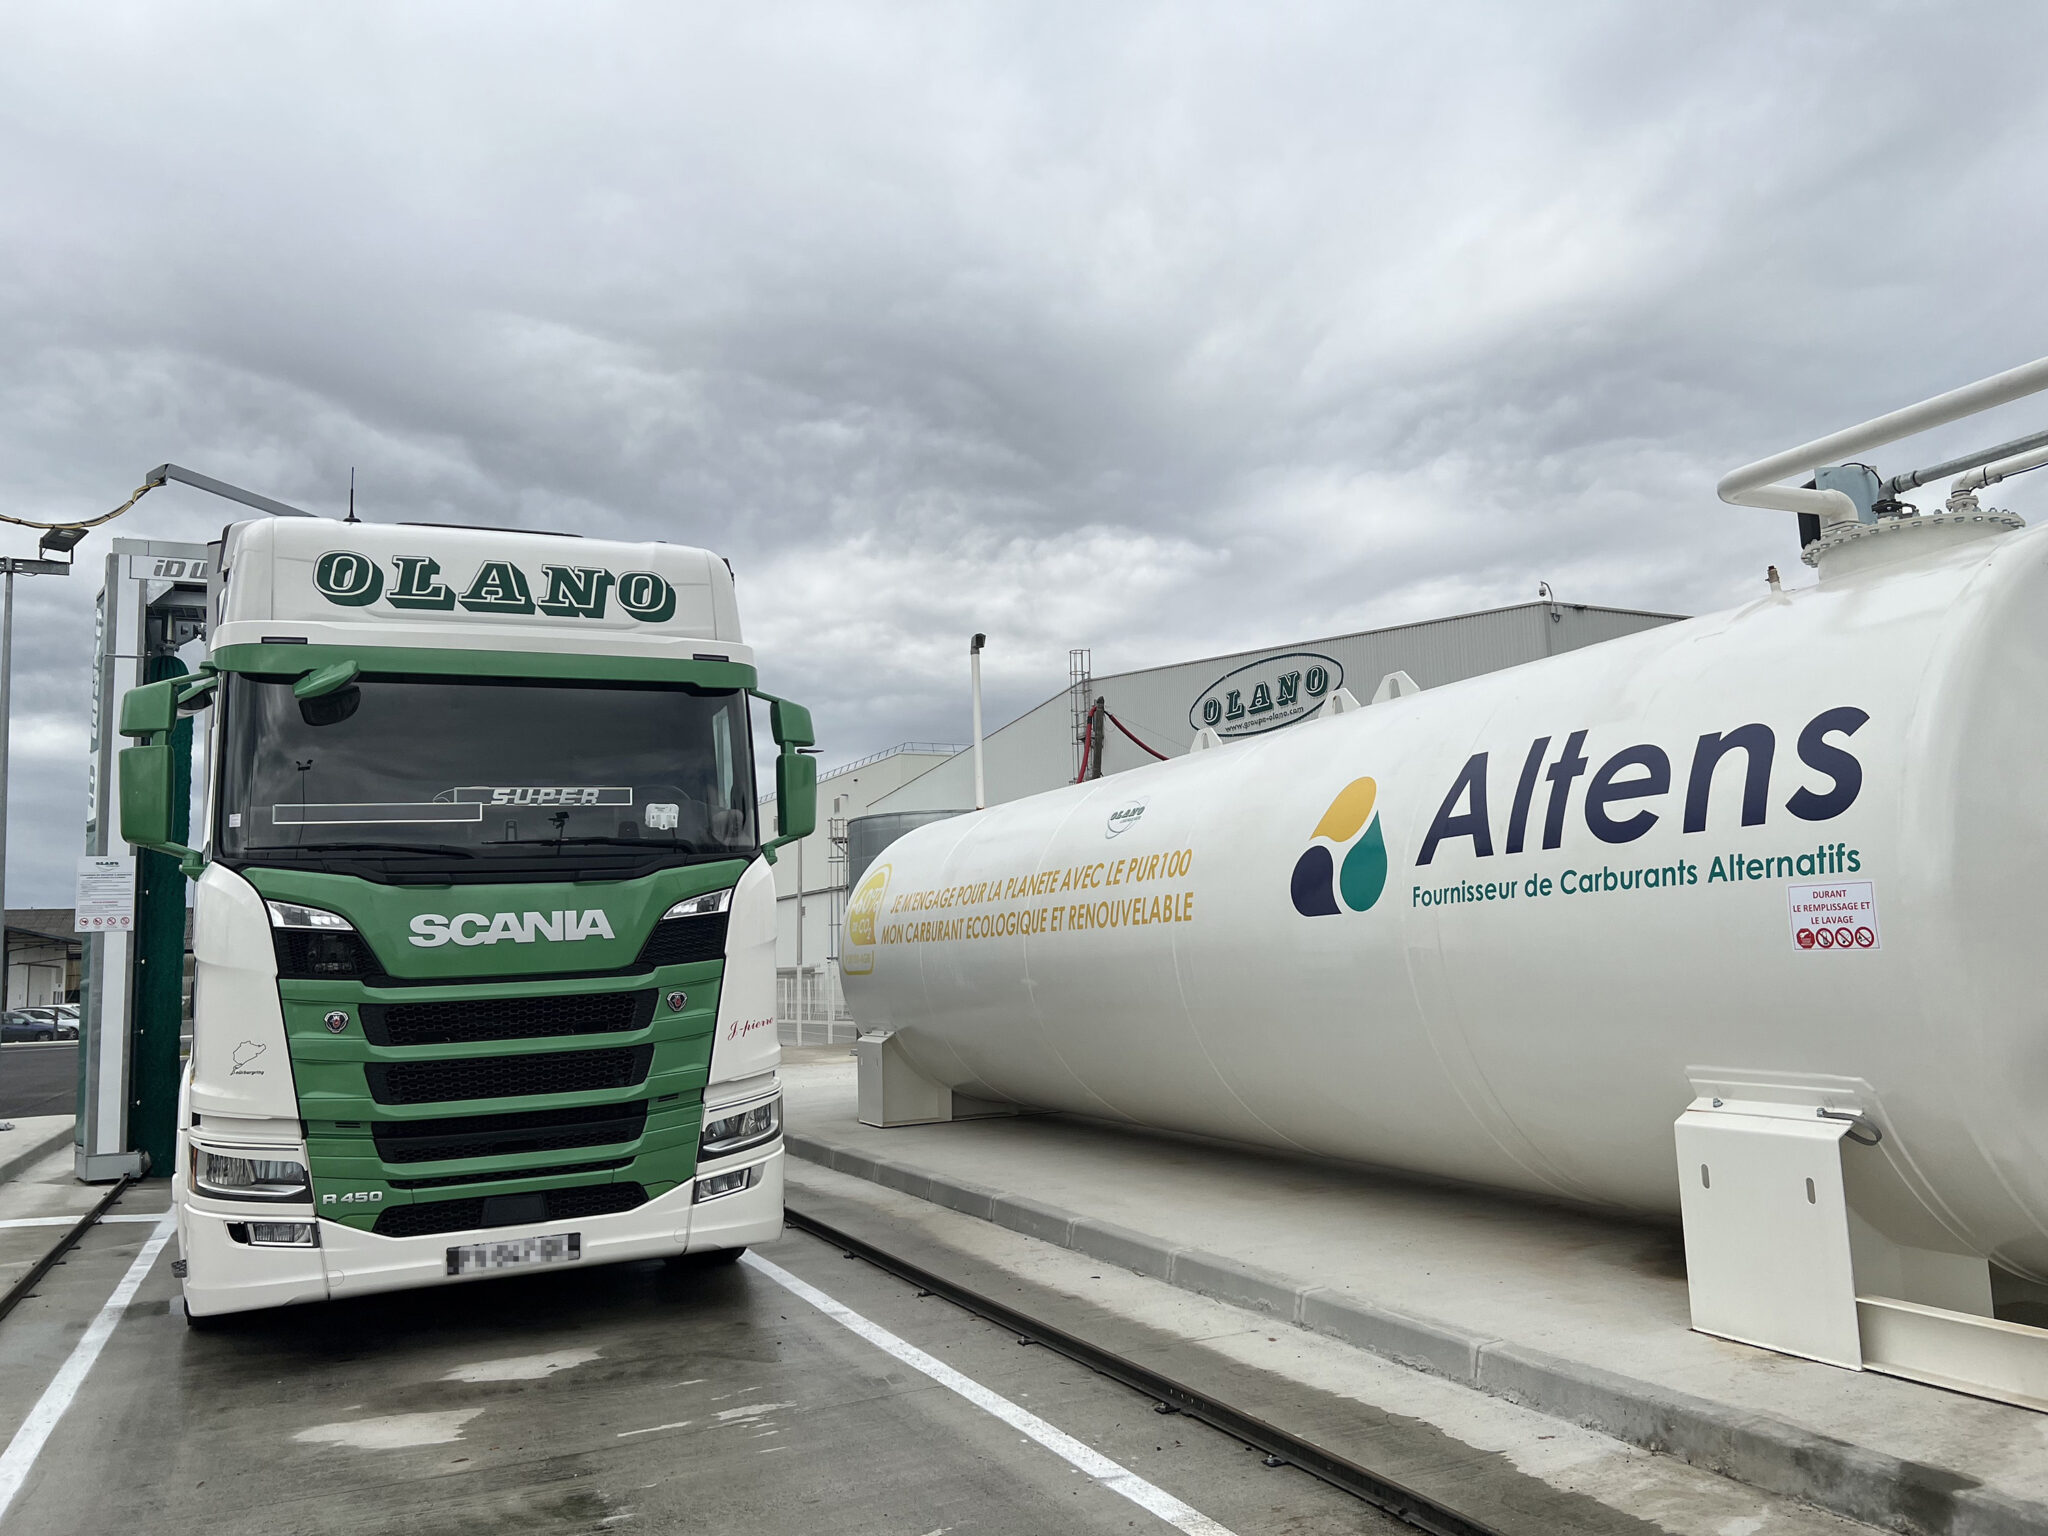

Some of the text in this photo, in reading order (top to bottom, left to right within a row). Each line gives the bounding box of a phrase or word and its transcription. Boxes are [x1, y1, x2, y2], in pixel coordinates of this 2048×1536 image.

[312, 550, 677, 624] OLANO
[1203, 664, 1329, 726] OLANO
[1224, 706, 1305, 733] www.groupe-olano.com
[490, 788, 600, 806] SUPER
[1415, 706, 1871, 867] Altens
[1110, 805, 1146, 821] OLANO
[889, 894, 903, 914] JE
[902, 886, 957, 913] M'ENGAGE
[955, 881, 988, 906] POUR
[987, 879, 1003, 902] LA
[1004, 869, 1061, 900] PLANETE
[1059, 862, 1105, 893] AVEC
[1105, 859, 1126, 886] LE
[1412, 842, 1862, 908] Fournisseur de Carburants Alternatifs
[1792, 901, 1871, 913] LE REMPLISSAGE ET
[1812, 889, 1847, 899] DURANT
[408, 908, 616, 948] SCANIA
[880, 923, 903, 945] MON
[905, 917, 965, 944] CARBURANT
[966, 907, 1048, 940] ECOLOGIQUE
[1050, 905, 1066, 932] ET
[1068, 891, 1194, 931] RENOUVELABLE
[1810, 915, 1854, 925] LE LAVAGE
[322, 1190, 384, 1206] R 450
